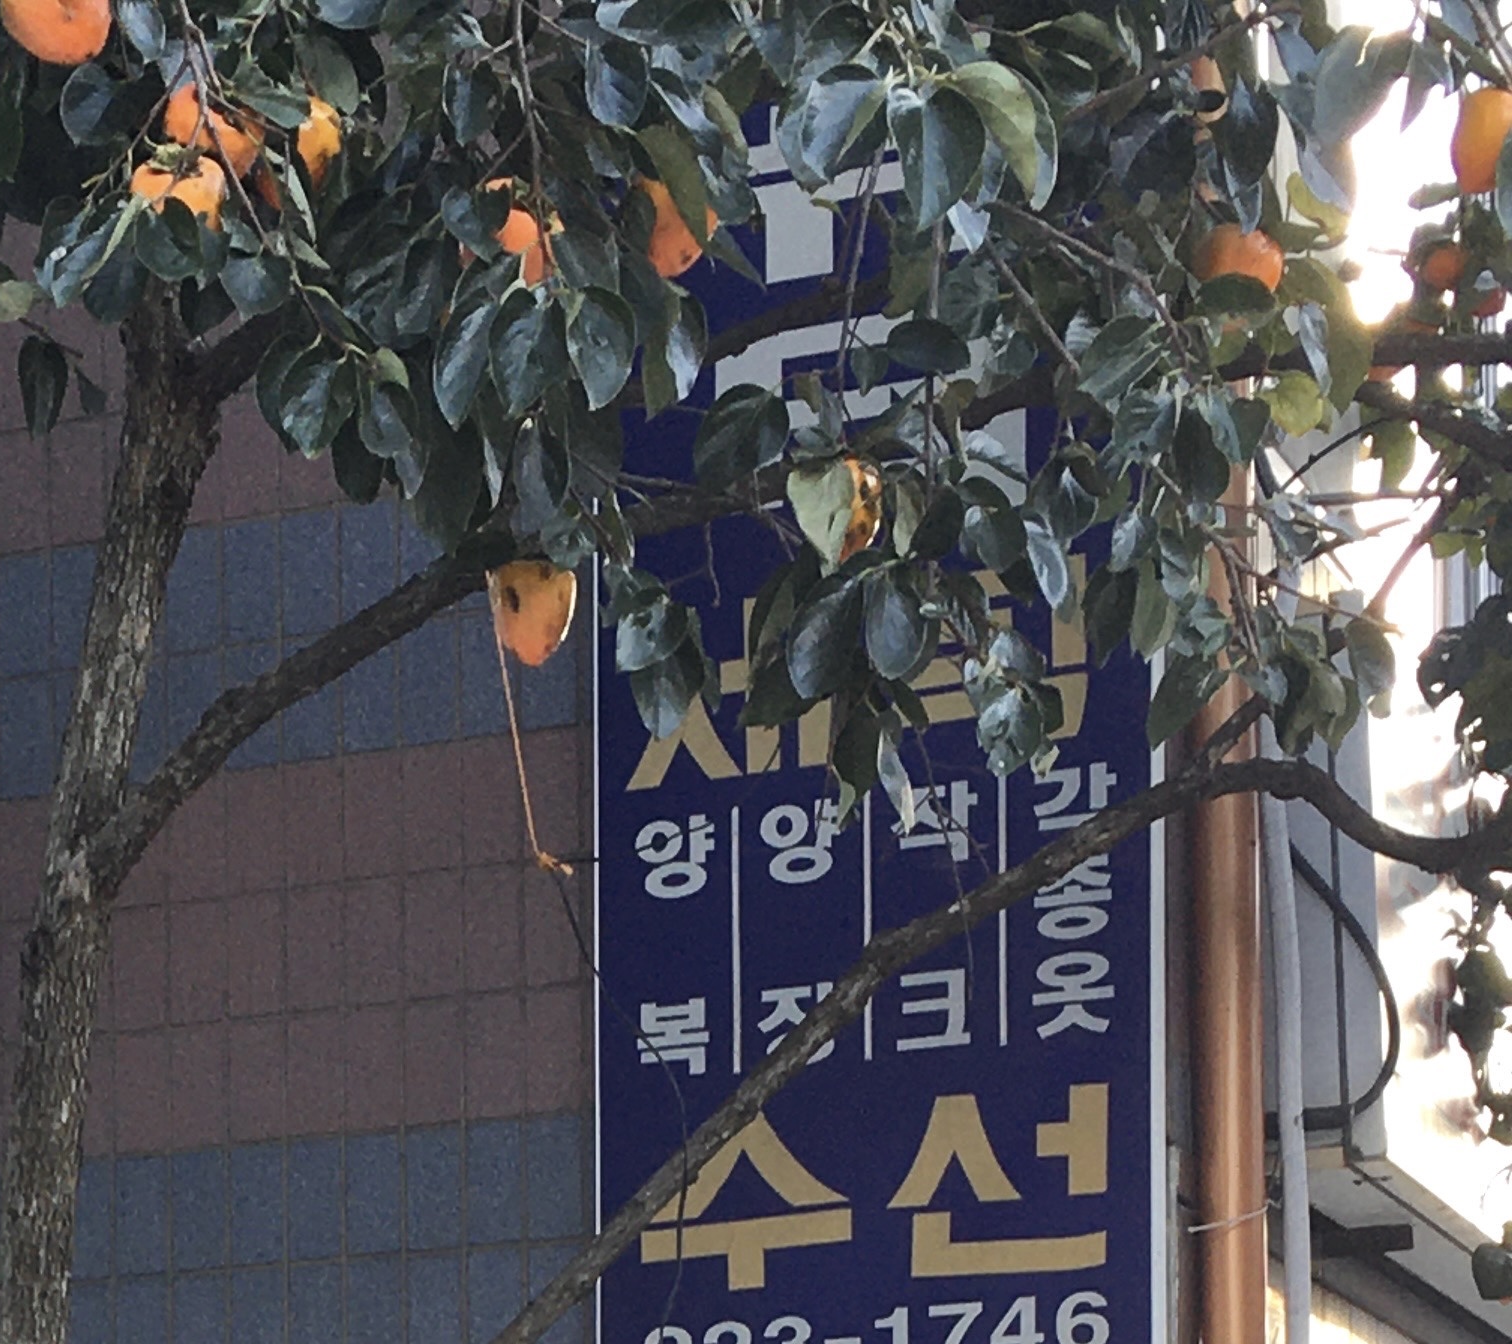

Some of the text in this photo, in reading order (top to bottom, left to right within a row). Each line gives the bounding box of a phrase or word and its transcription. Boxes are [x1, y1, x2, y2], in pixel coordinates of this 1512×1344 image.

[635, 813, 715, 1076] 양복
[1032, 761, 1118, 1040] 각종옷
[640, 1082, 1110, 1291] 수선
